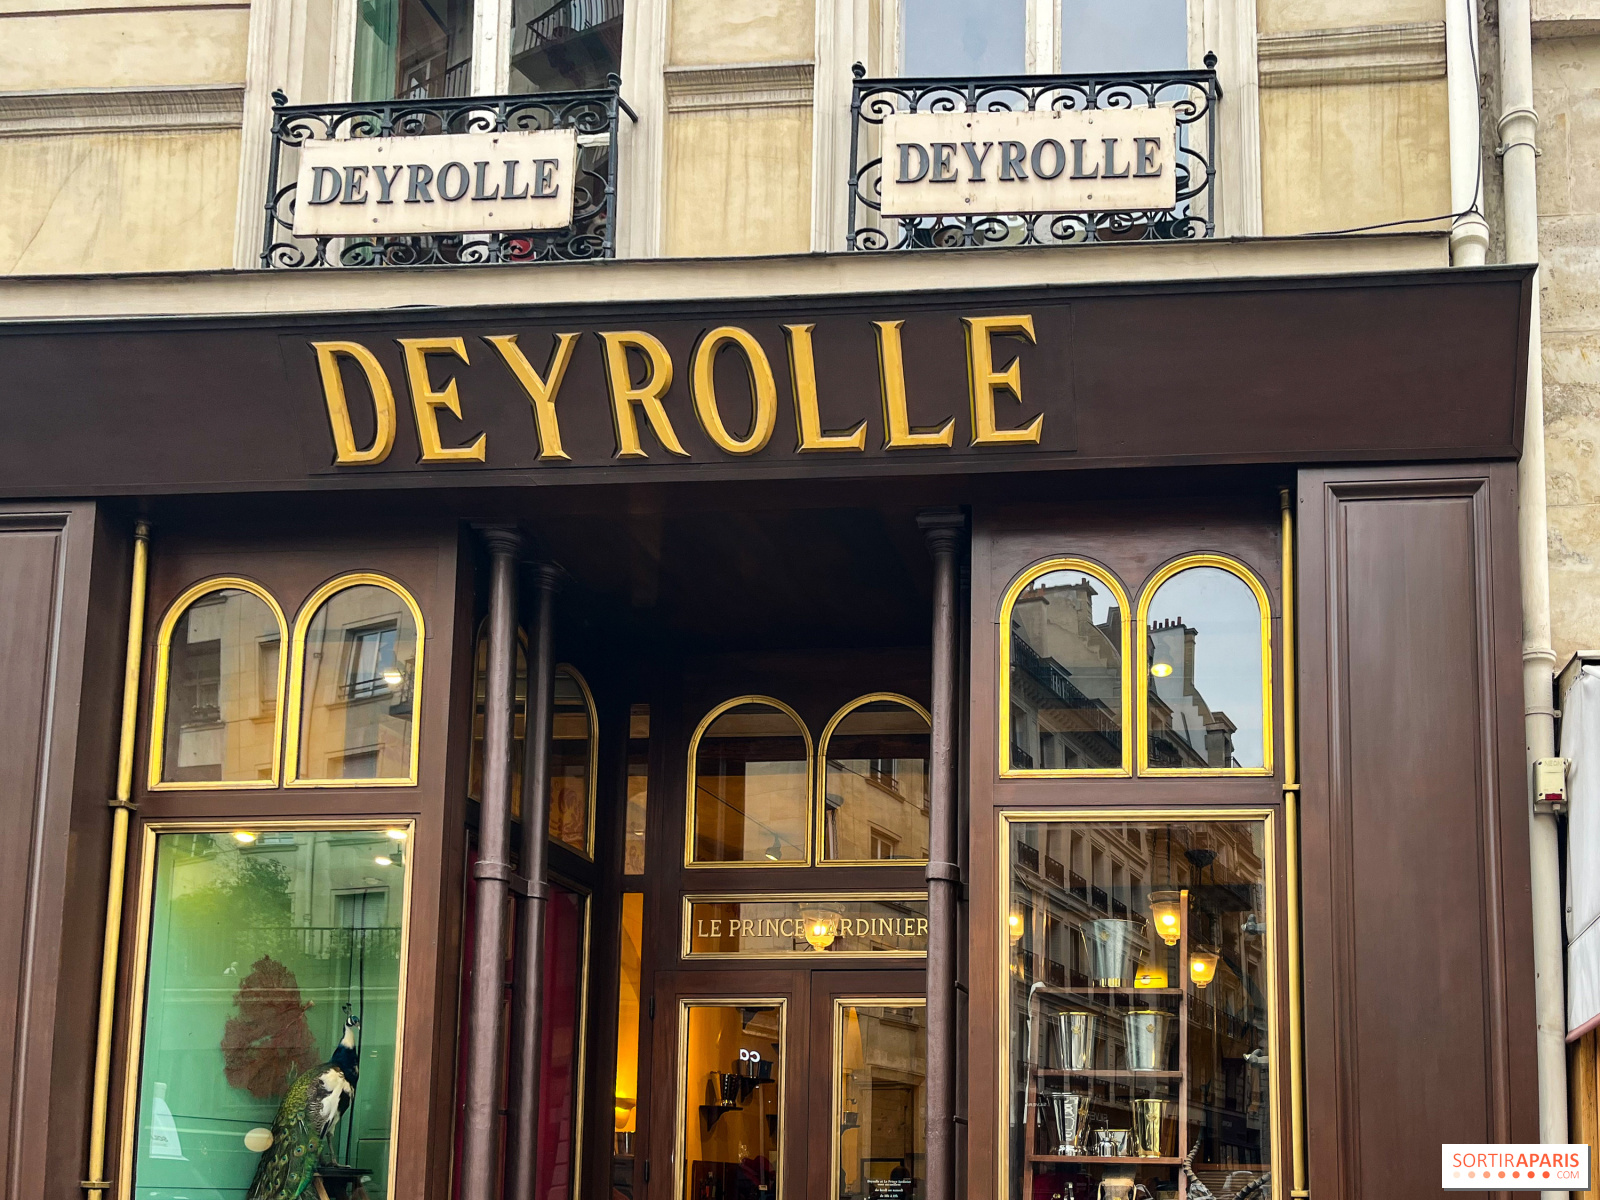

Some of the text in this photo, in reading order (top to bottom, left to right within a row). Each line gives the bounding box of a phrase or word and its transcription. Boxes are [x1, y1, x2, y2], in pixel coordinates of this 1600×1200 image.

[307, 158, 560, 205] DEYROLLE
[895, 137, 1163, 183] DEYROLLE
[308, 314, 1044, 467] DEYROLLE
[697, 919, 722, 937] LE
[728, 918, 805, 937] PRINCE
